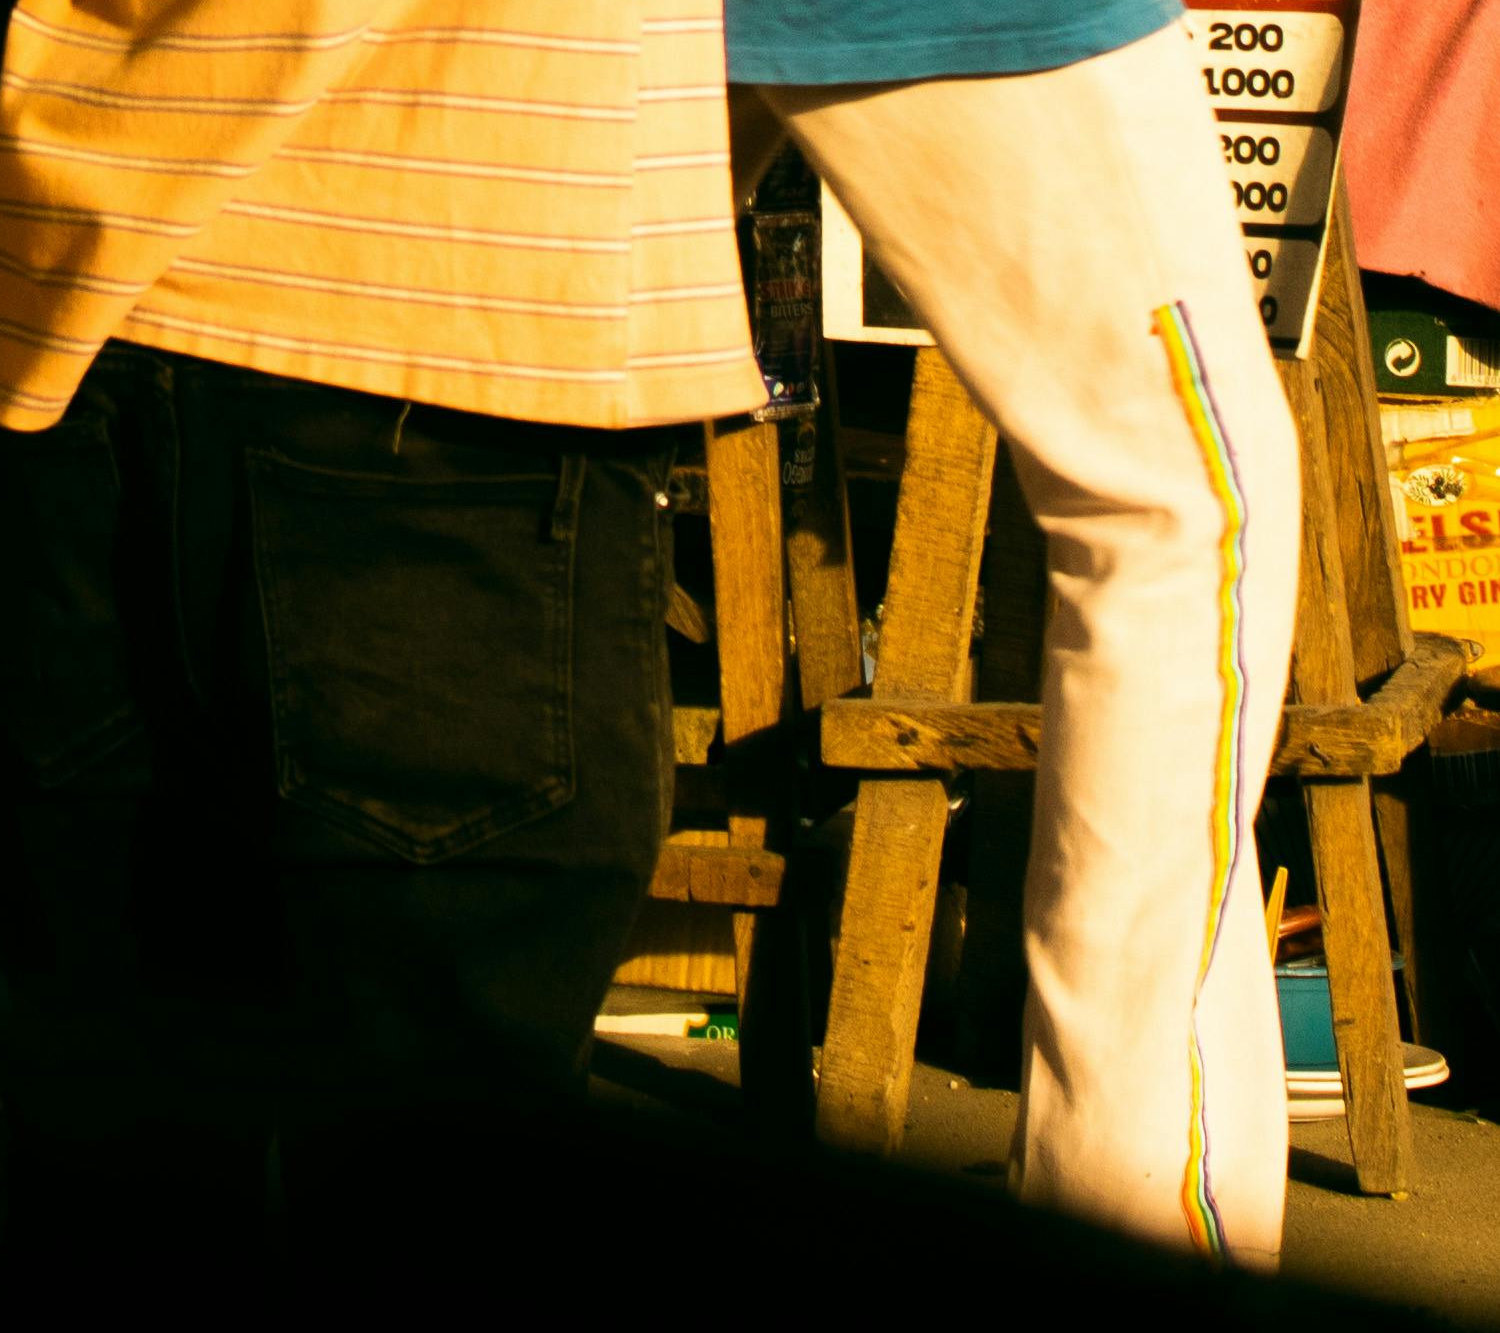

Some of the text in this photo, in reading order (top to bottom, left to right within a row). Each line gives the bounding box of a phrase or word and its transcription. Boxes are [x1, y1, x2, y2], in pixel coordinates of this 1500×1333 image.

[1209, 23, 1284, 53] 200
[1203, 68, 1295, 98] 1000
[1404, 580, 1454, 611] RY
